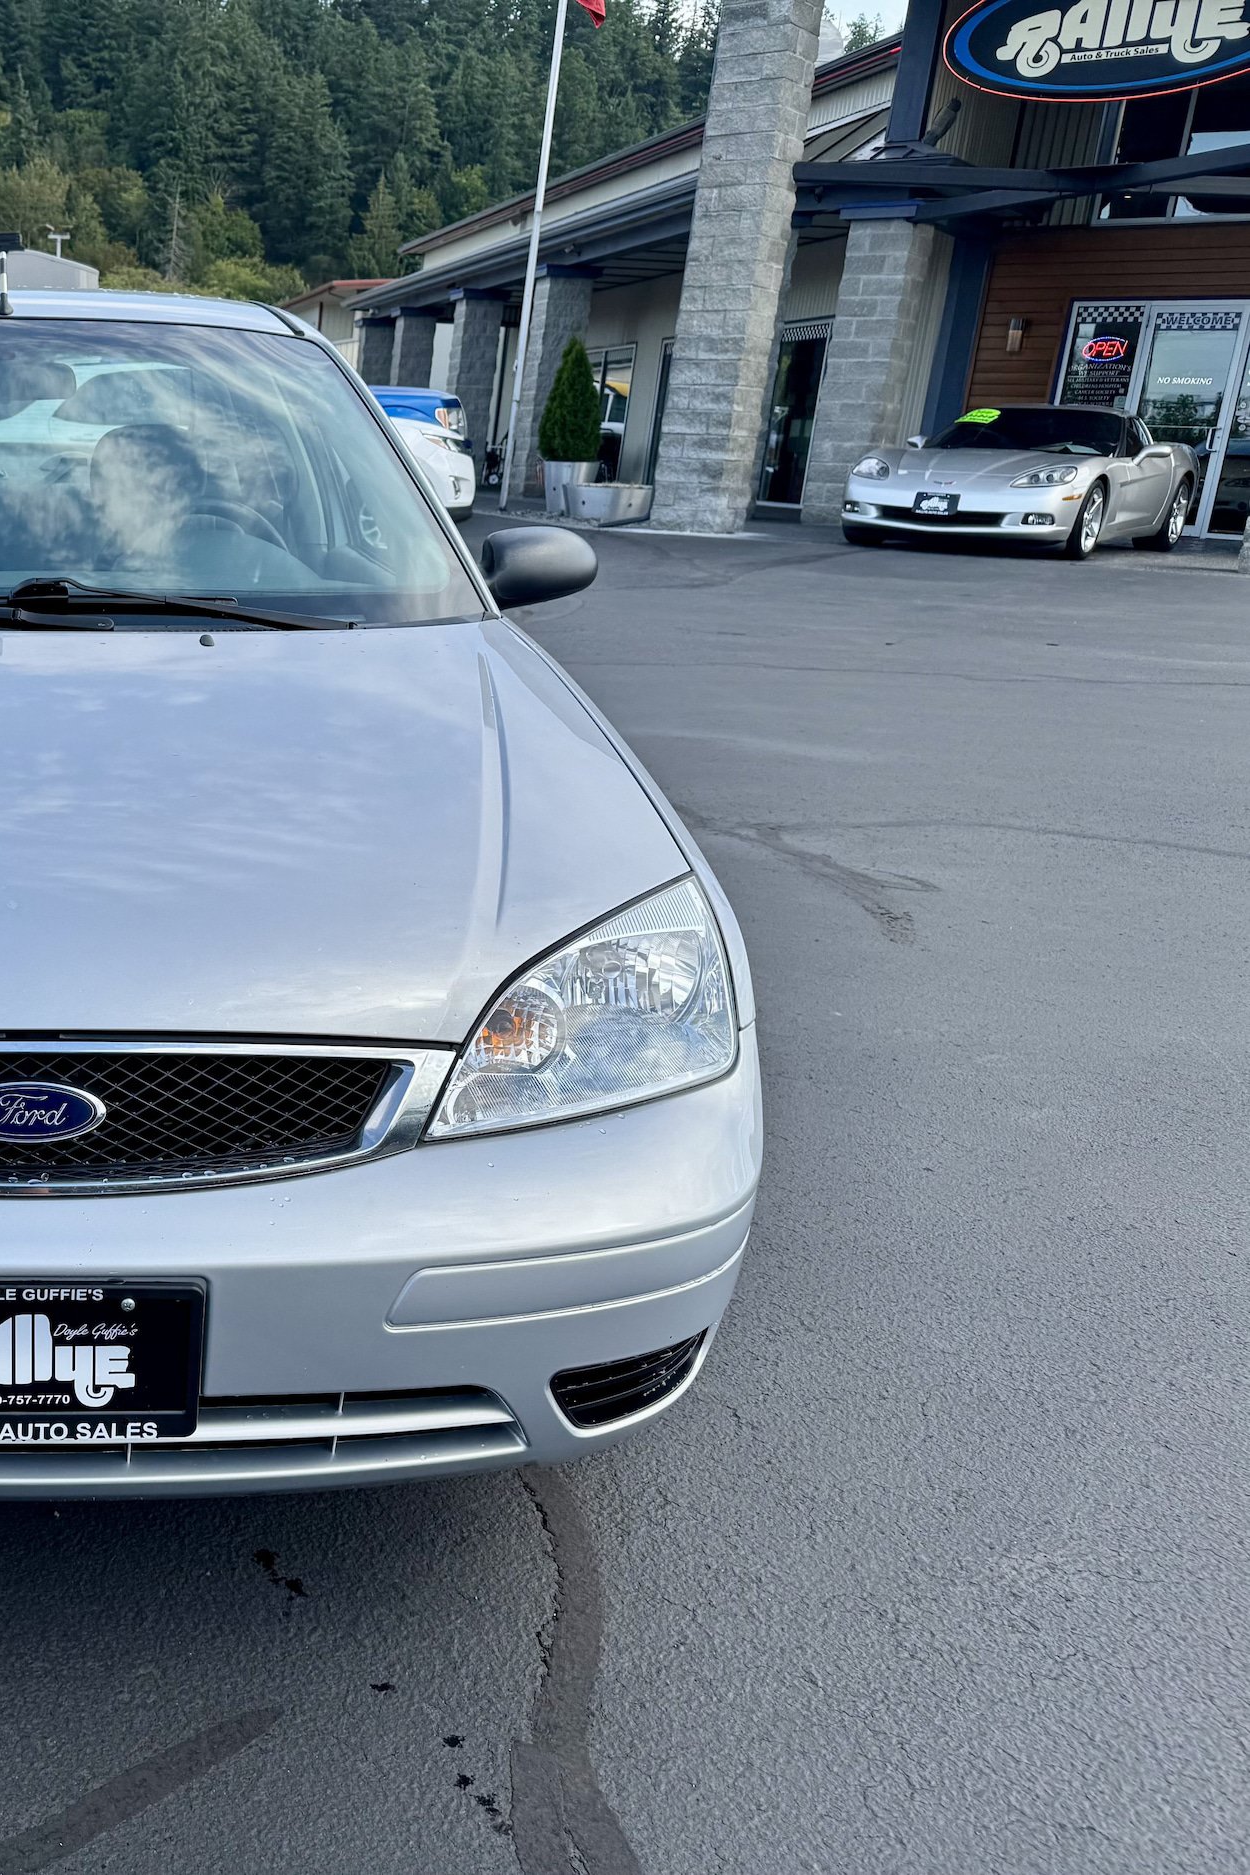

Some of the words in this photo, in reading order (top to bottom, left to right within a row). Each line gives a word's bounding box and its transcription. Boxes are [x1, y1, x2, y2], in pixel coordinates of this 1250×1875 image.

[1070, 51, 1094, 62] Auto
[1095, 51, 1103, 60] &
[1104, 48, 1132, 59] Truck
[1133, 46, 1160, 56] Sales
[1165, 315, 1233, 327] WELCOME
[1082, 339, 1129, 358] OPEN
[1157, 377, 1170, 385] NO
[1171, 377, 1213, 386] SMOKING
[22, 1288, 104, 1301] GUFFIE'S
[53, 1323, 90, 1341] Doyle
[91, 1322, 139, 1341] Guffie's
[0, 1422, 69, 1441] AUTO
[75, 1421, 158, 1440] SALES
